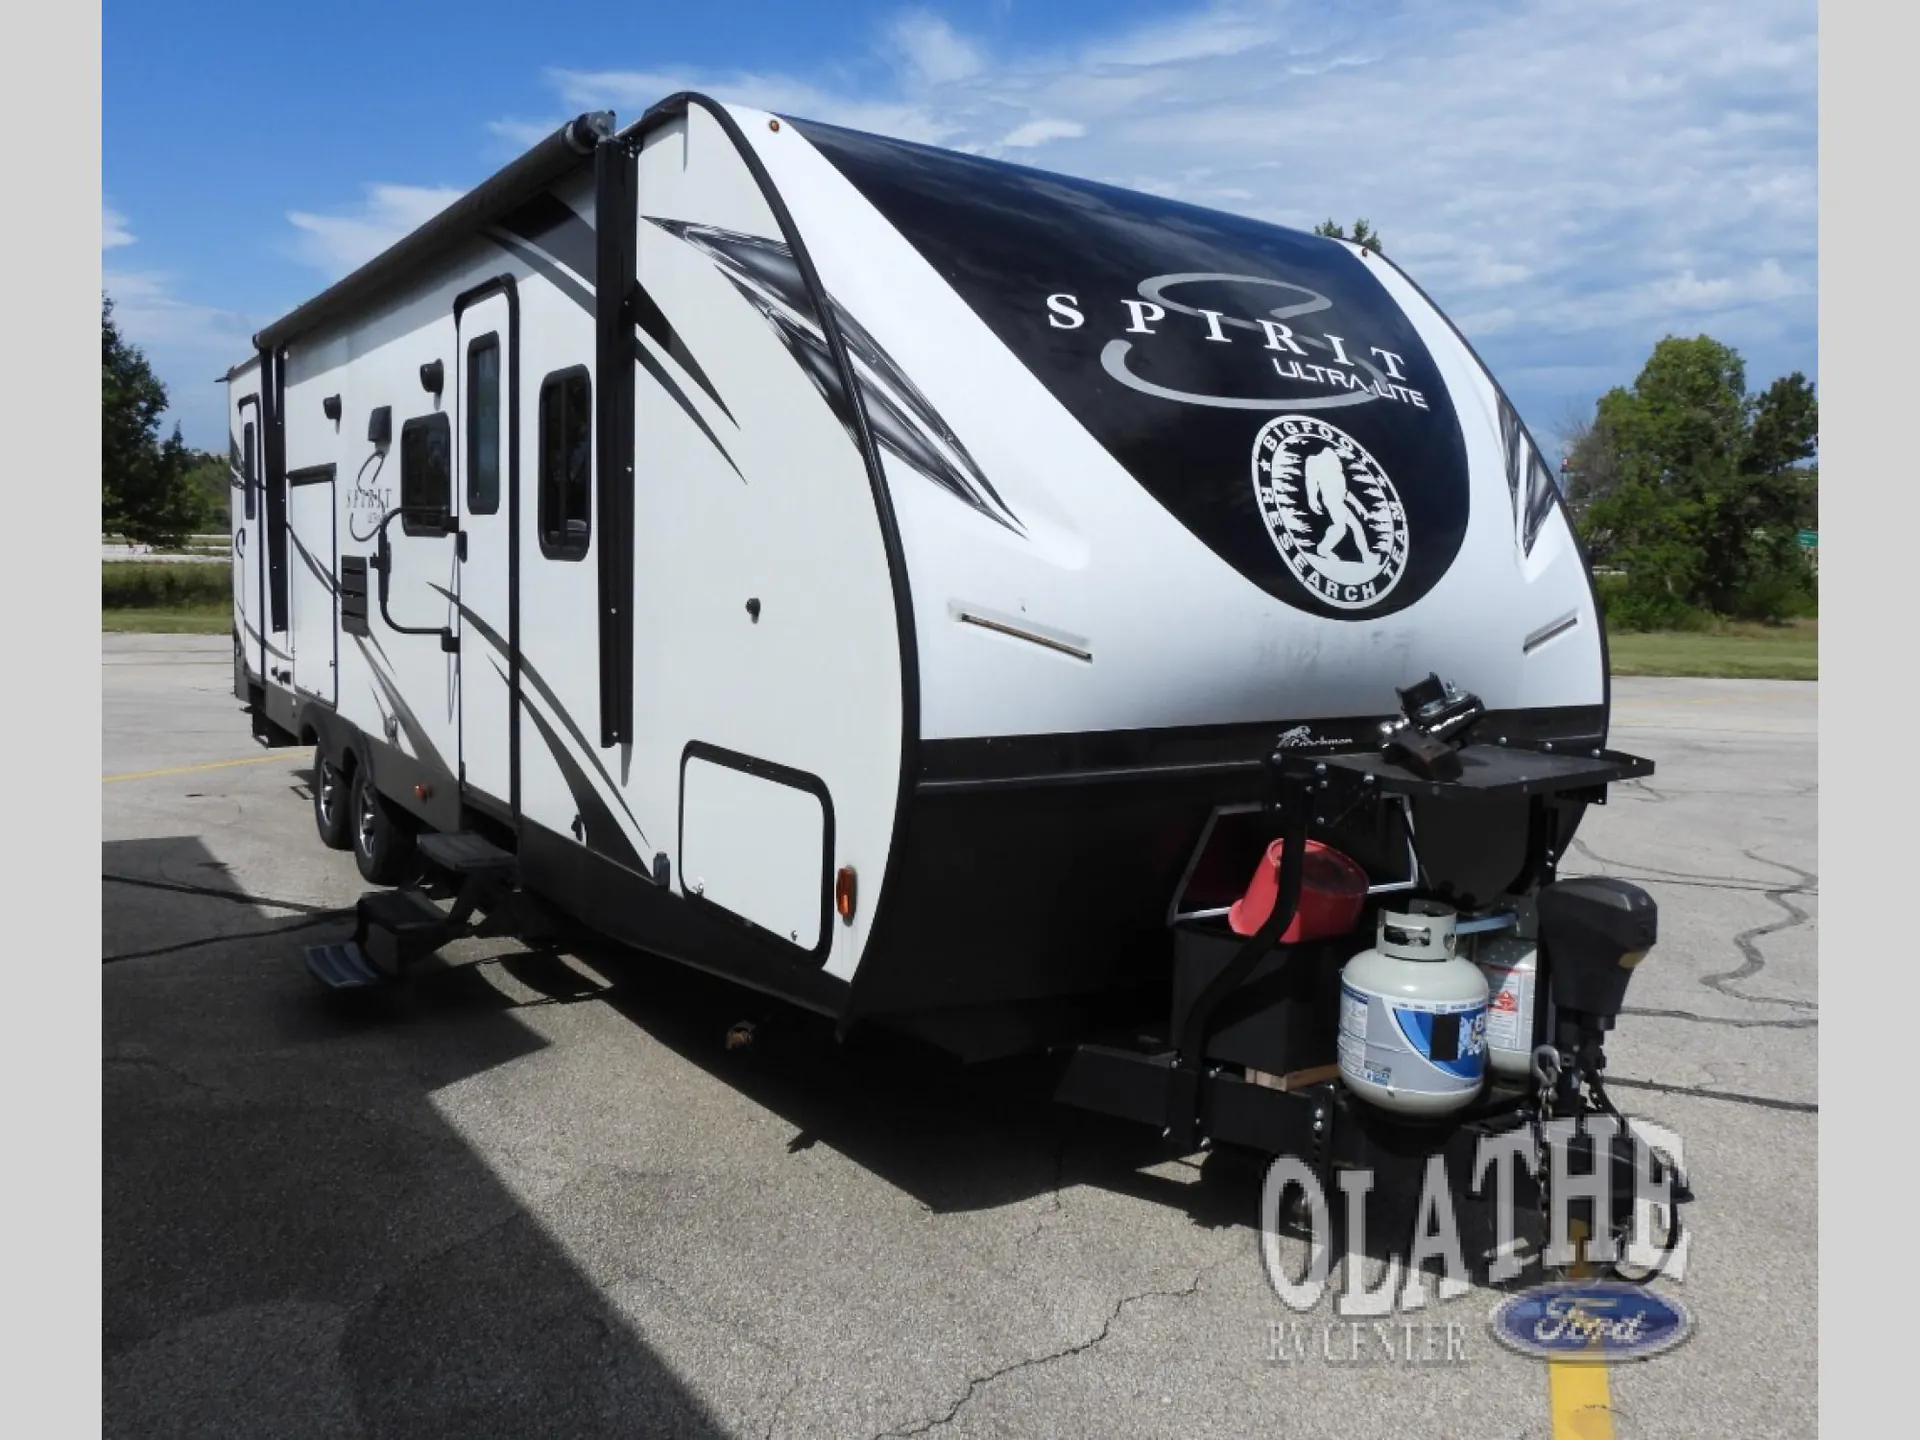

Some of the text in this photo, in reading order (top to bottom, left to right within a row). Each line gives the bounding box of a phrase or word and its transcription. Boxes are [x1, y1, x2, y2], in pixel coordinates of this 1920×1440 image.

[1046, 294, 1405, 380] SPIRIT
[1272, 357, 1428, 409] ULTRA LITE
[1263, 421, 1373, 465] BIGFOOT
[1260, 487, 1407, 602] RESEARCH TEAM
